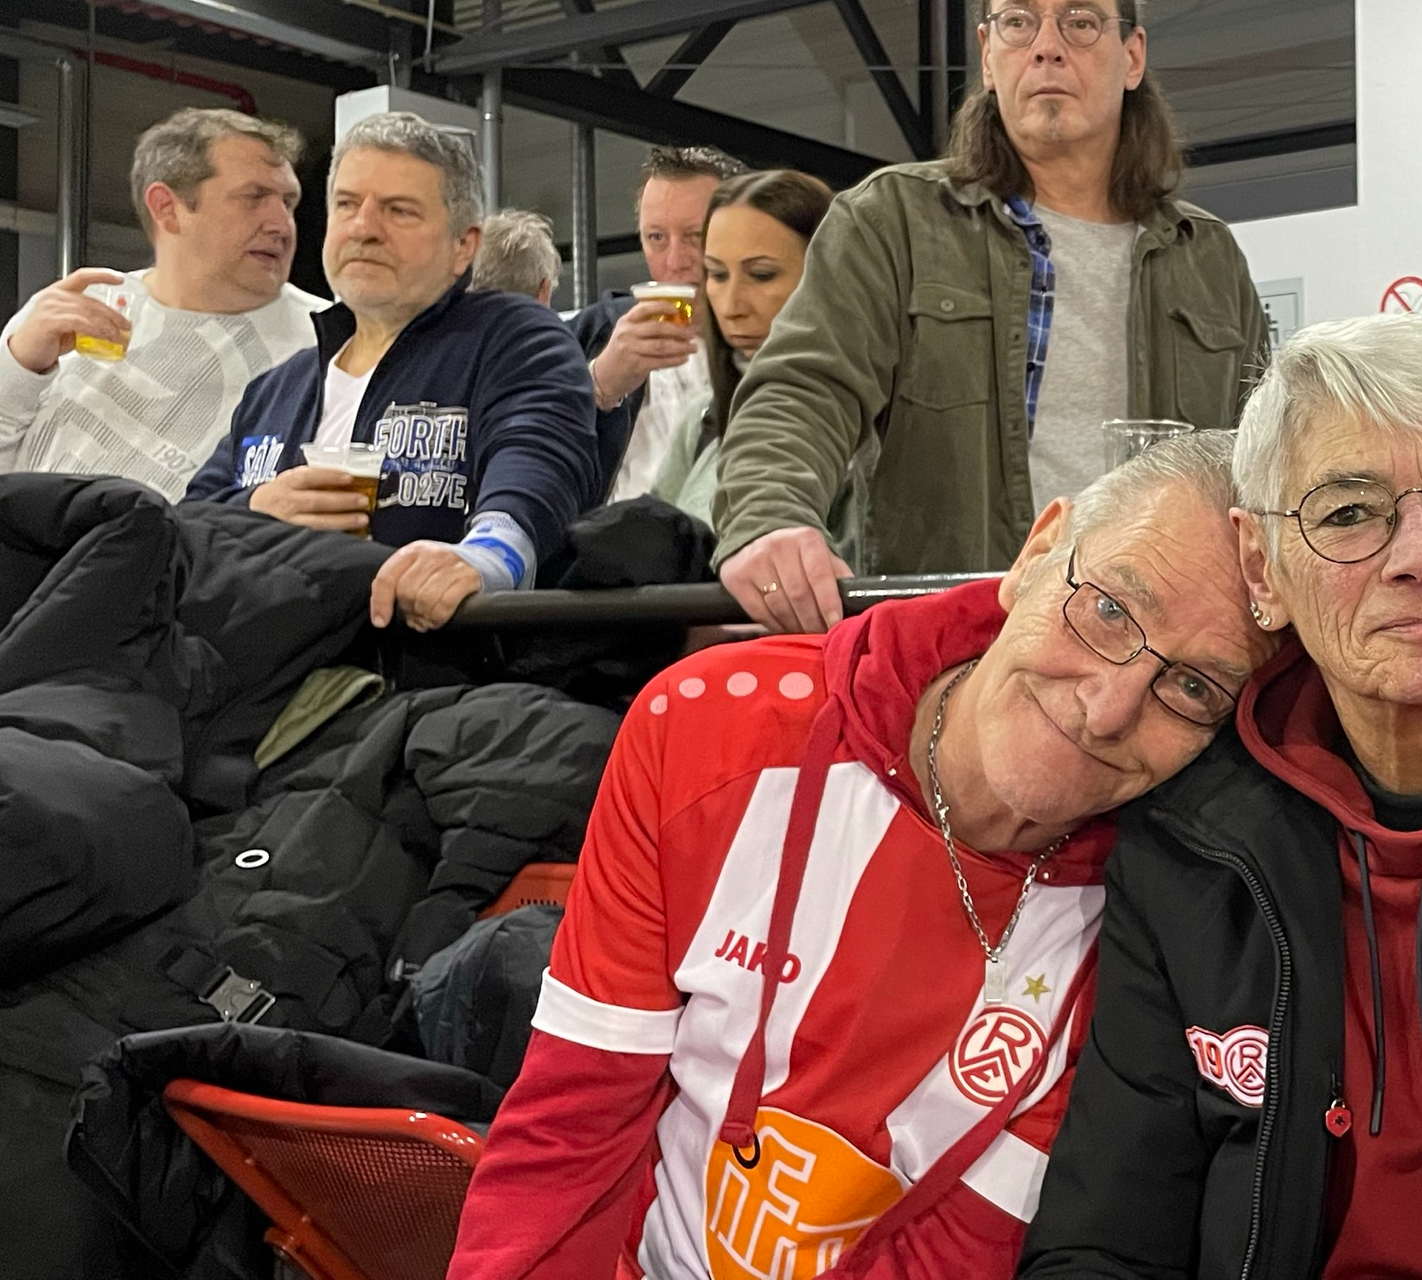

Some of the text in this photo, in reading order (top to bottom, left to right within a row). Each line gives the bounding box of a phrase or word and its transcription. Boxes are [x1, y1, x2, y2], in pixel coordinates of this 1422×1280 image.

[152, 443, 198, 475] 1907
[713, 928, 802, 984] JAKO
[1194, 1036, 1224, 1080] 19
